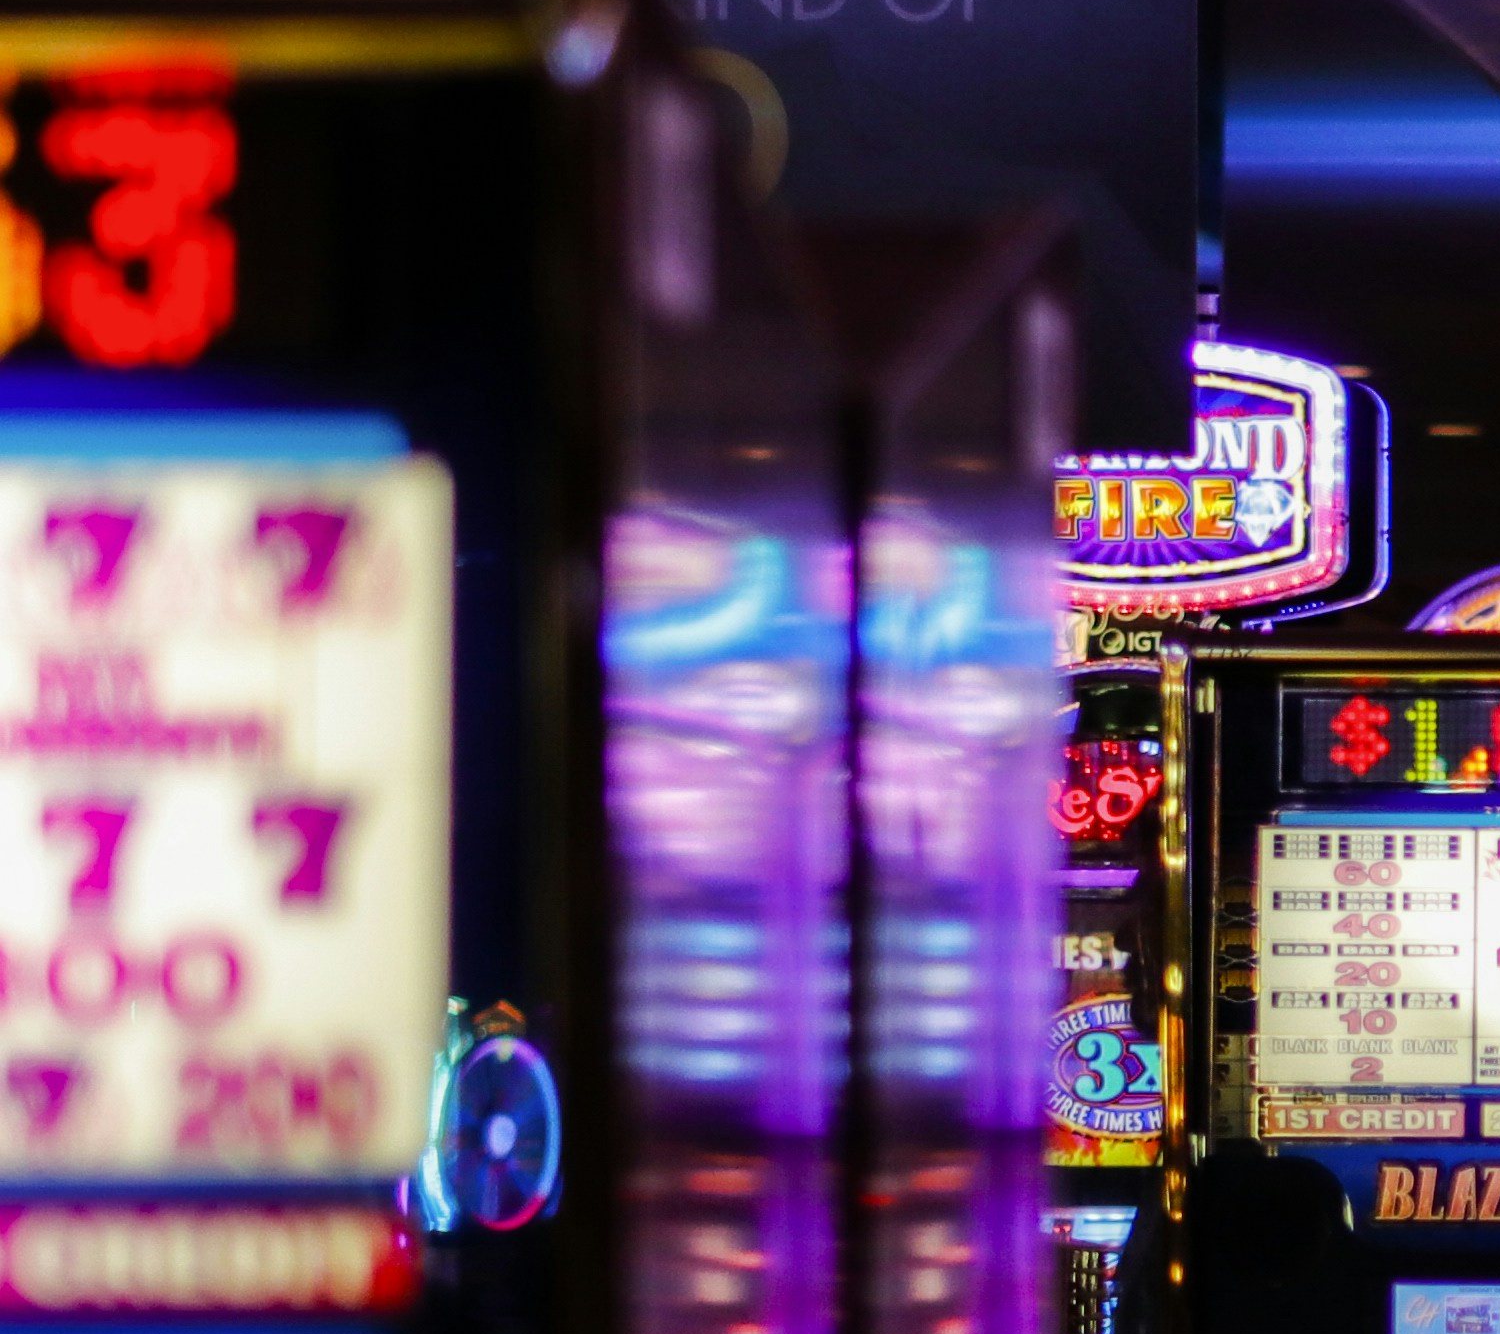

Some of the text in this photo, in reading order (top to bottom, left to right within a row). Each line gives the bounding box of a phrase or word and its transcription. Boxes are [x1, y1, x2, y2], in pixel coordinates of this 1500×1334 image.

[1053, 477, 1238, 542] FIRE
[1334, 861, 1402, 887] 60
[1333, 913, 1402, 939] 40
[1334, 961, 1402, 987] 20
[1339, 1008, 1398, 1035] 10
[1273, 1038, 1458, 1055] BLANK BLANK BLANK
[1350, 1056, 1385, 1082] 2
[1273, 1107, 1459, 1132] 1ST CREDIT
